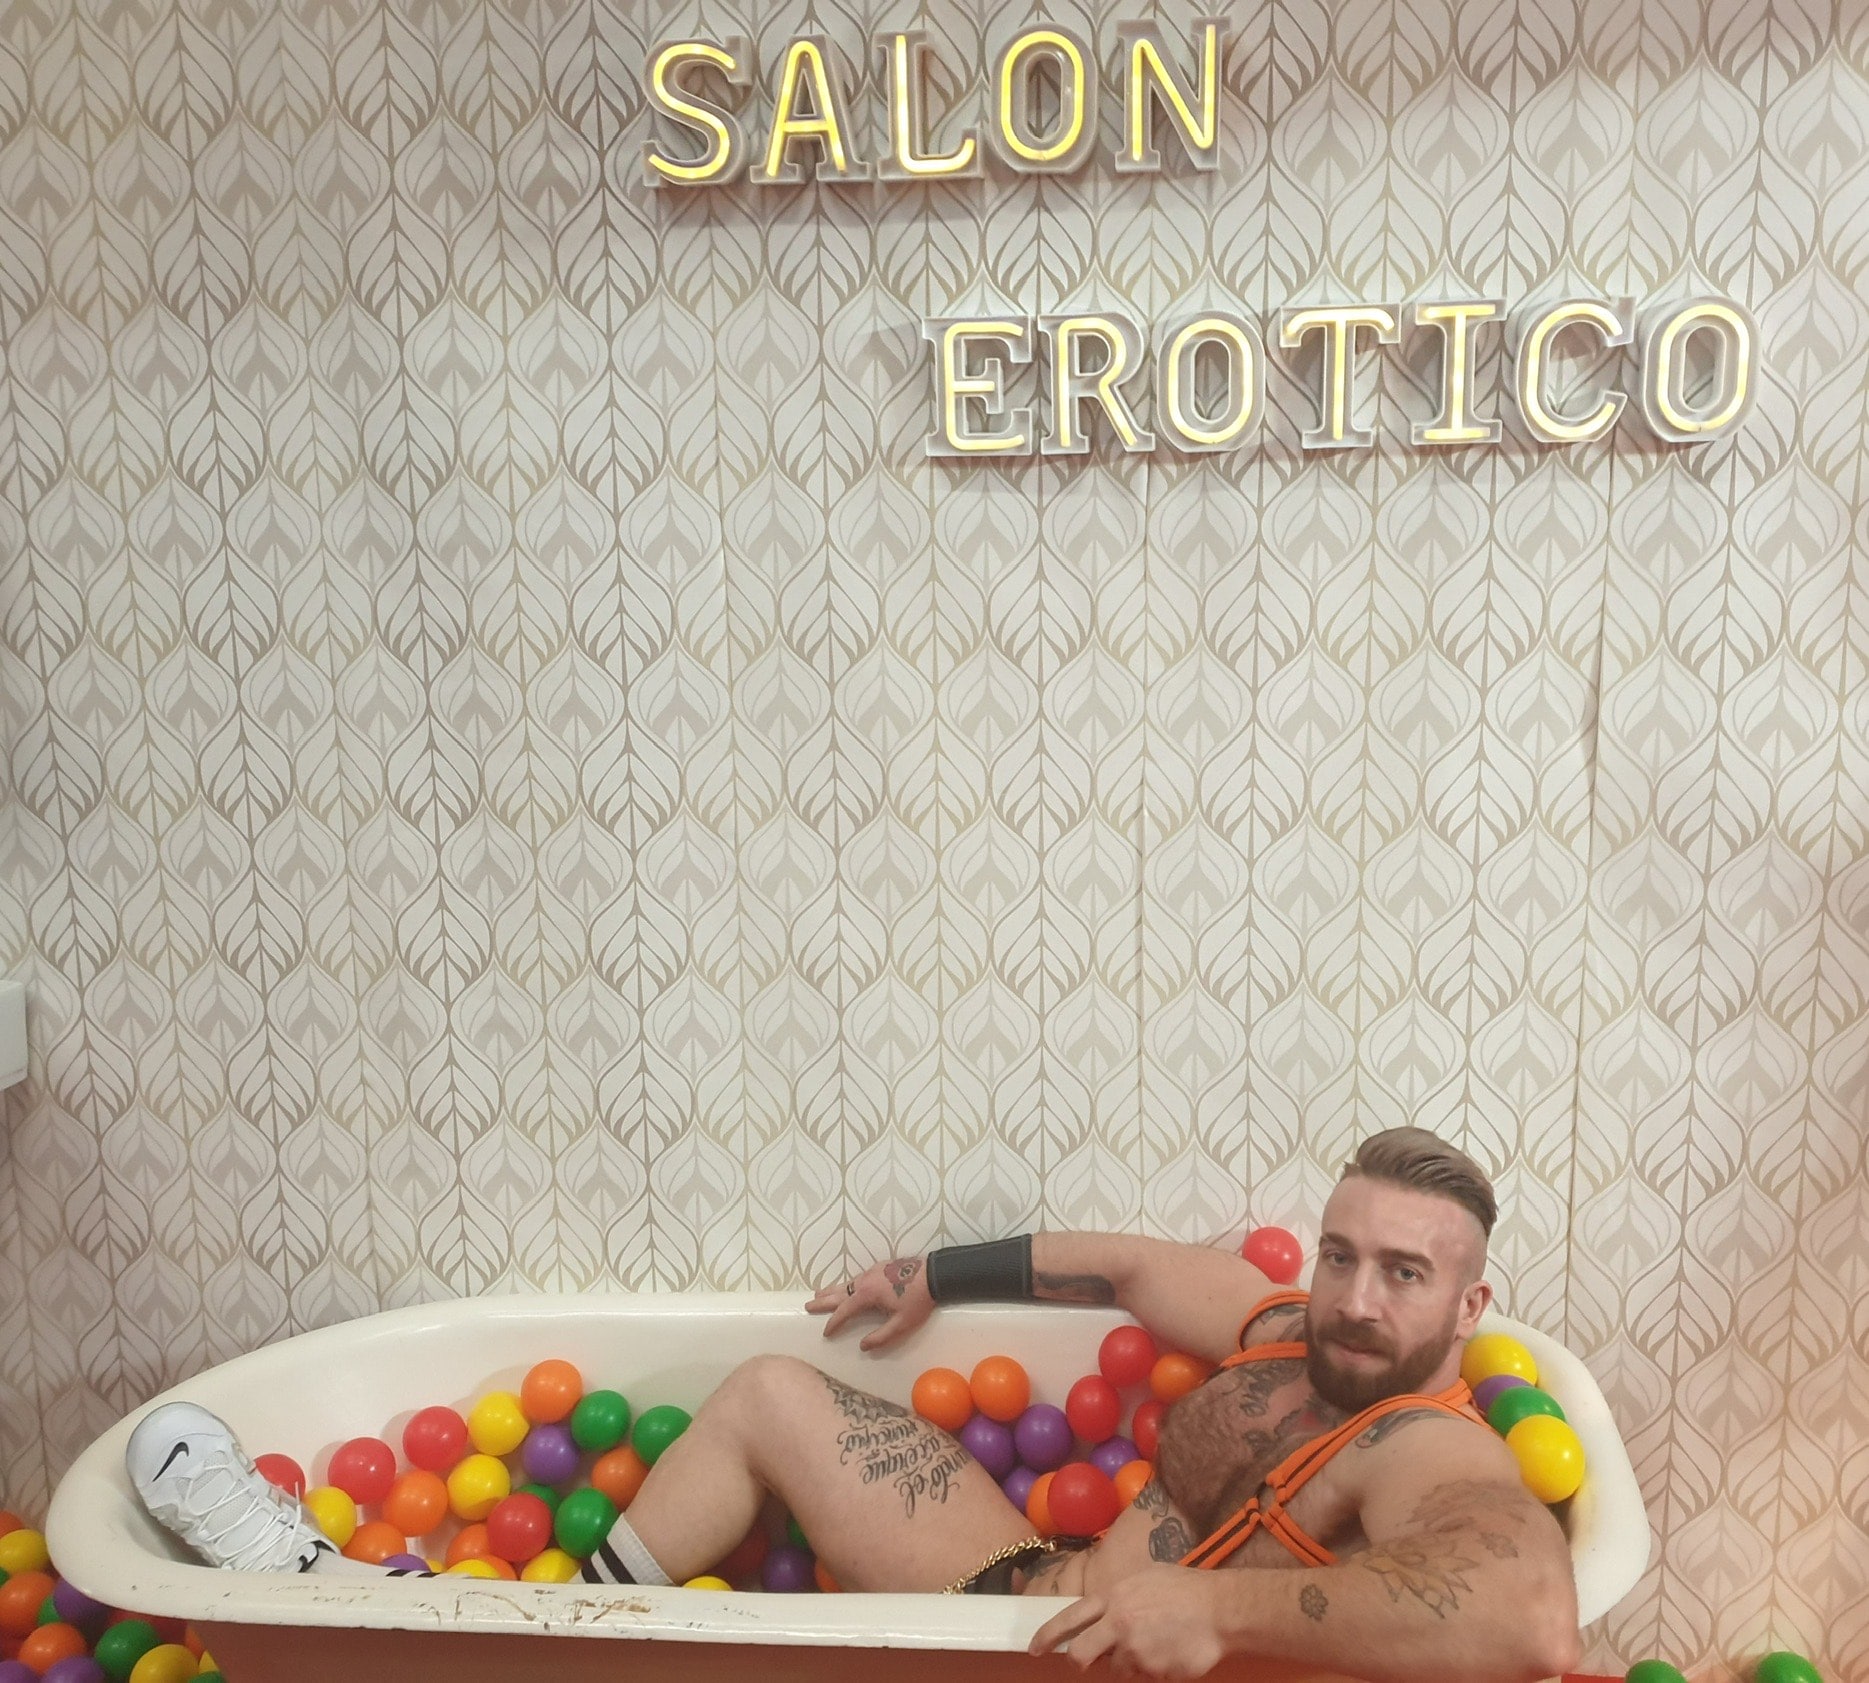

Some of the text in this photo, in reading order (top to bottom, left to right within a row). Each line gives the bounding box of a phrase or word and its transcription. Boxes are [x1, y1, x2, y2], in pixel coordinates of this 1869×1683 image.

[644, 16, 1231, 188] SALON
[924, 296, 1760, 457] EROTICO
[897, 1473, 927, 1519] el
